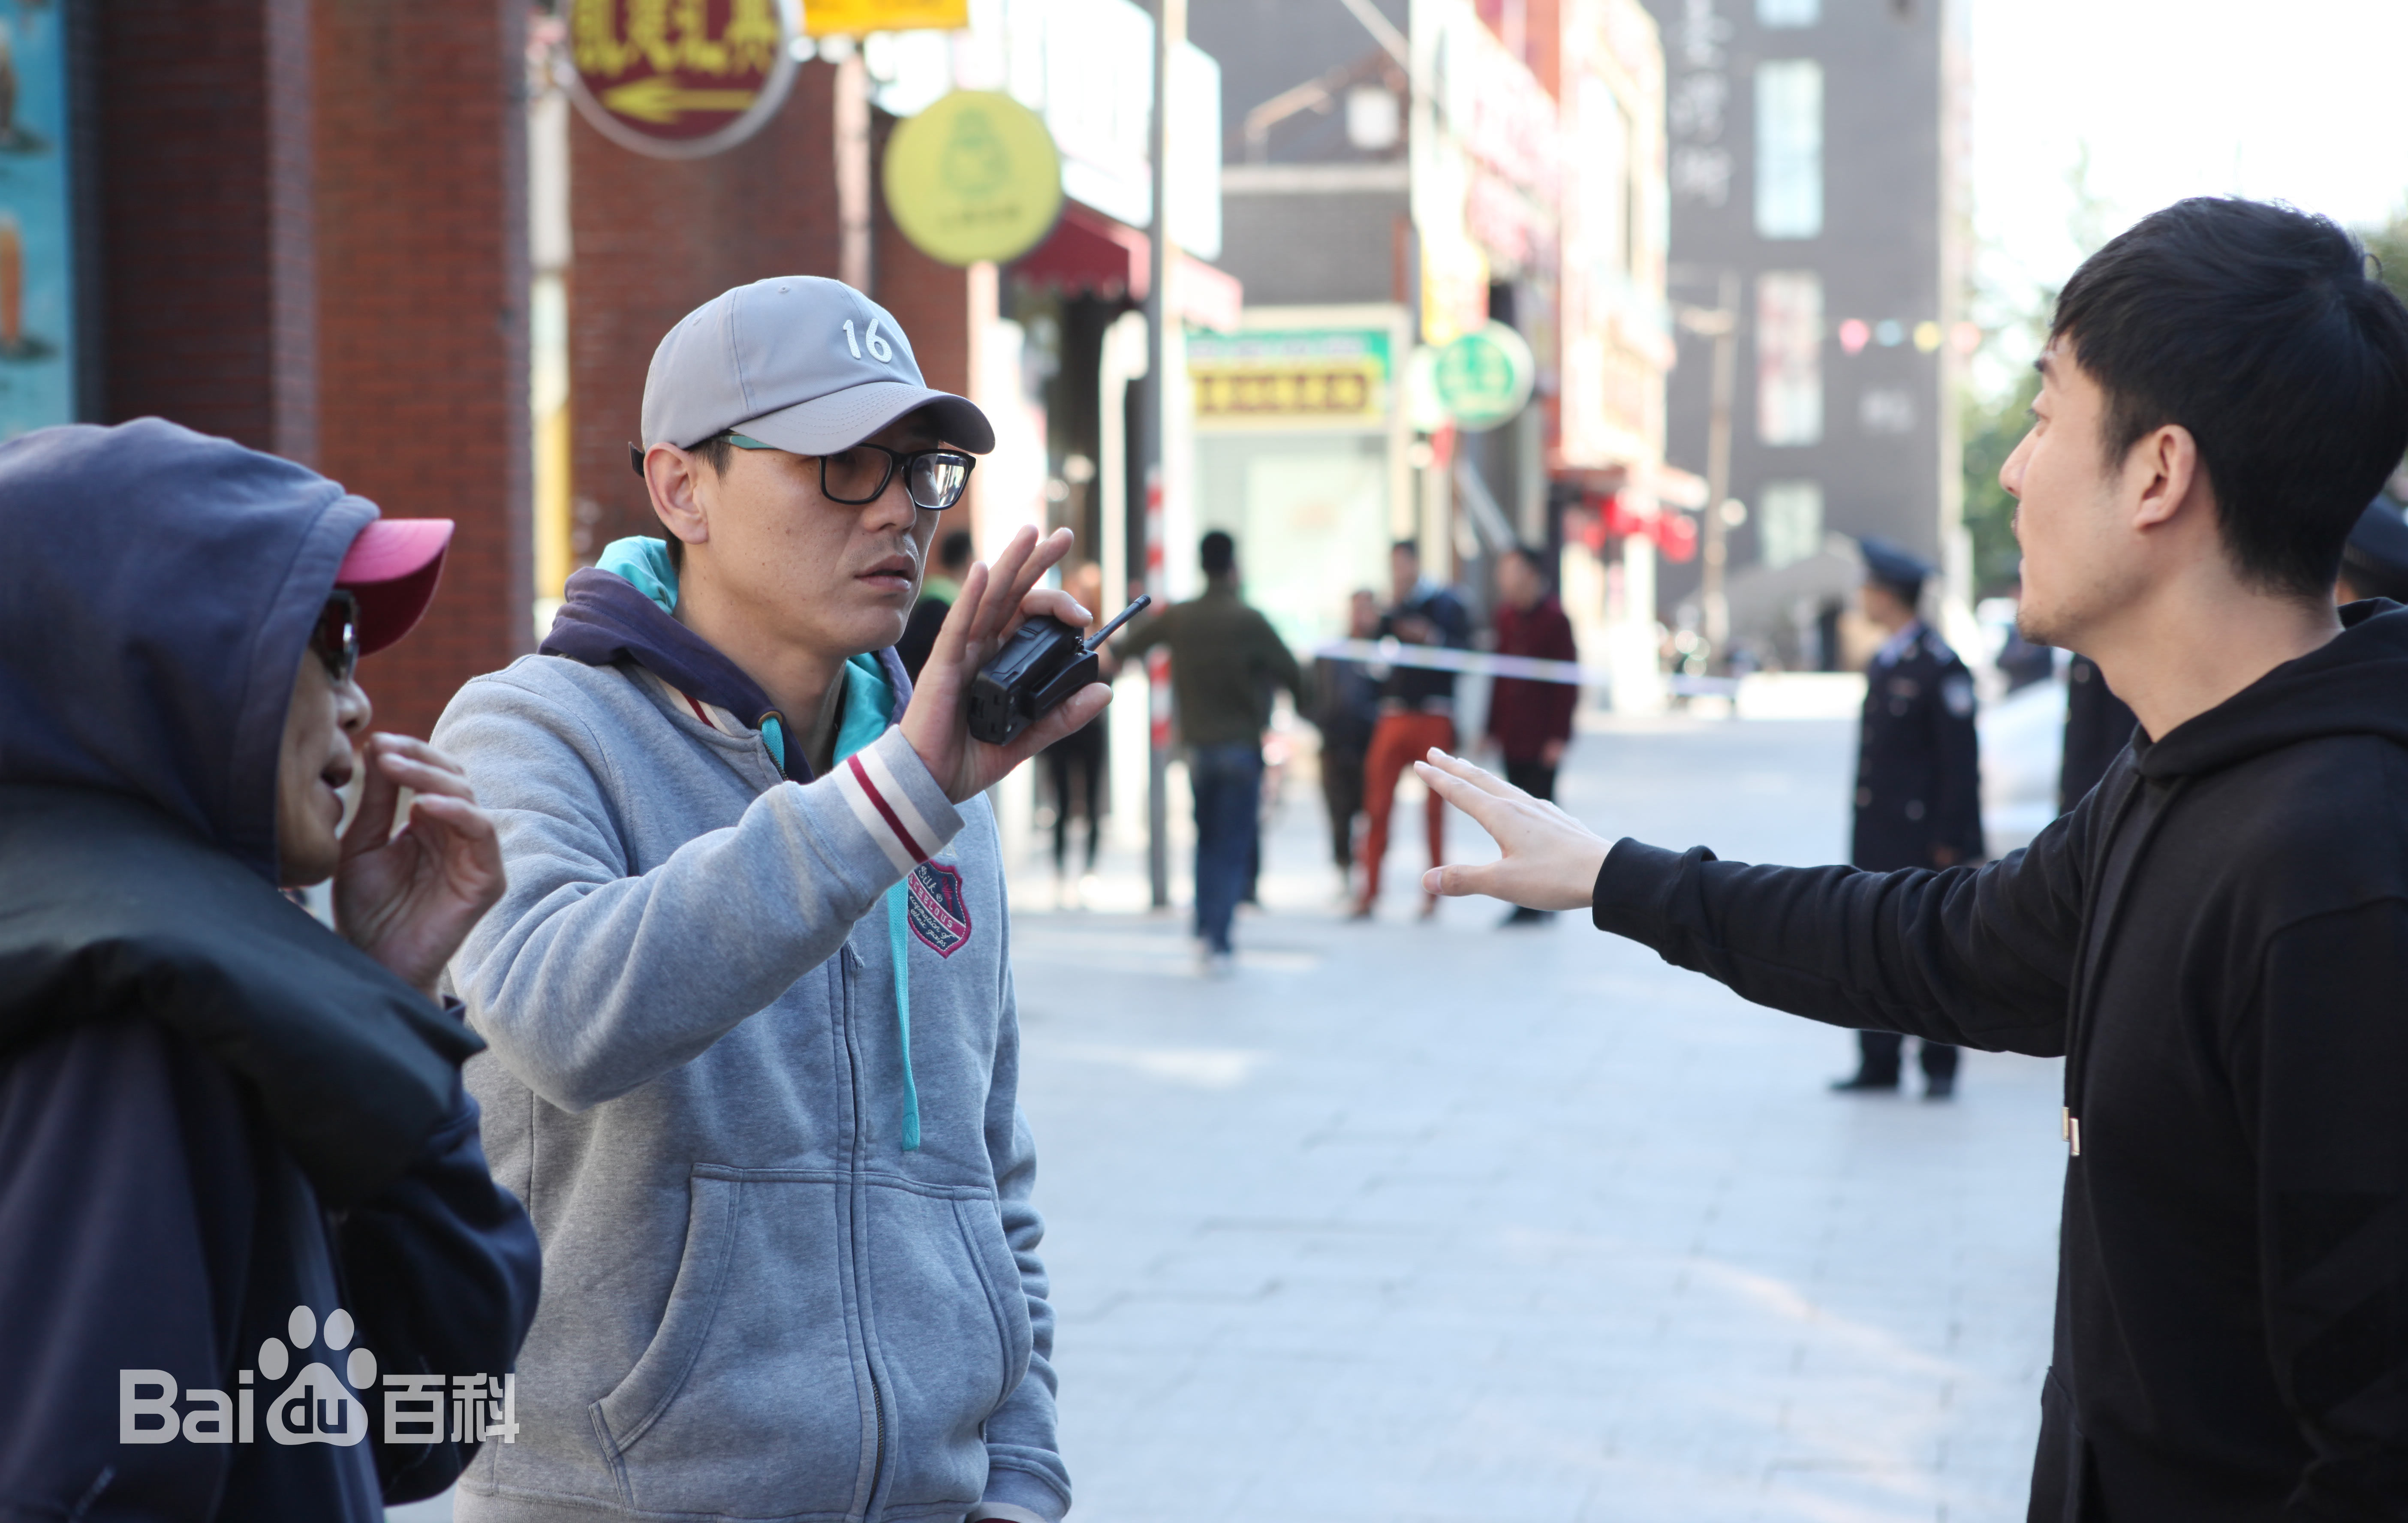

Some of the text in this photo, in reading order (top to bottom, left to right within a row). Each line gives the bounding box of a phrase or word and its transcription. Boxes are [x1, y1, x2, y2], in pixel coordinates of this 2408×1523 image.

[843, 318, 892, 364] 16
[918, 865, 937, 894] Silk
[910, 908, 947, 947] ethnic groups
[941, 931, 955, 939] of
